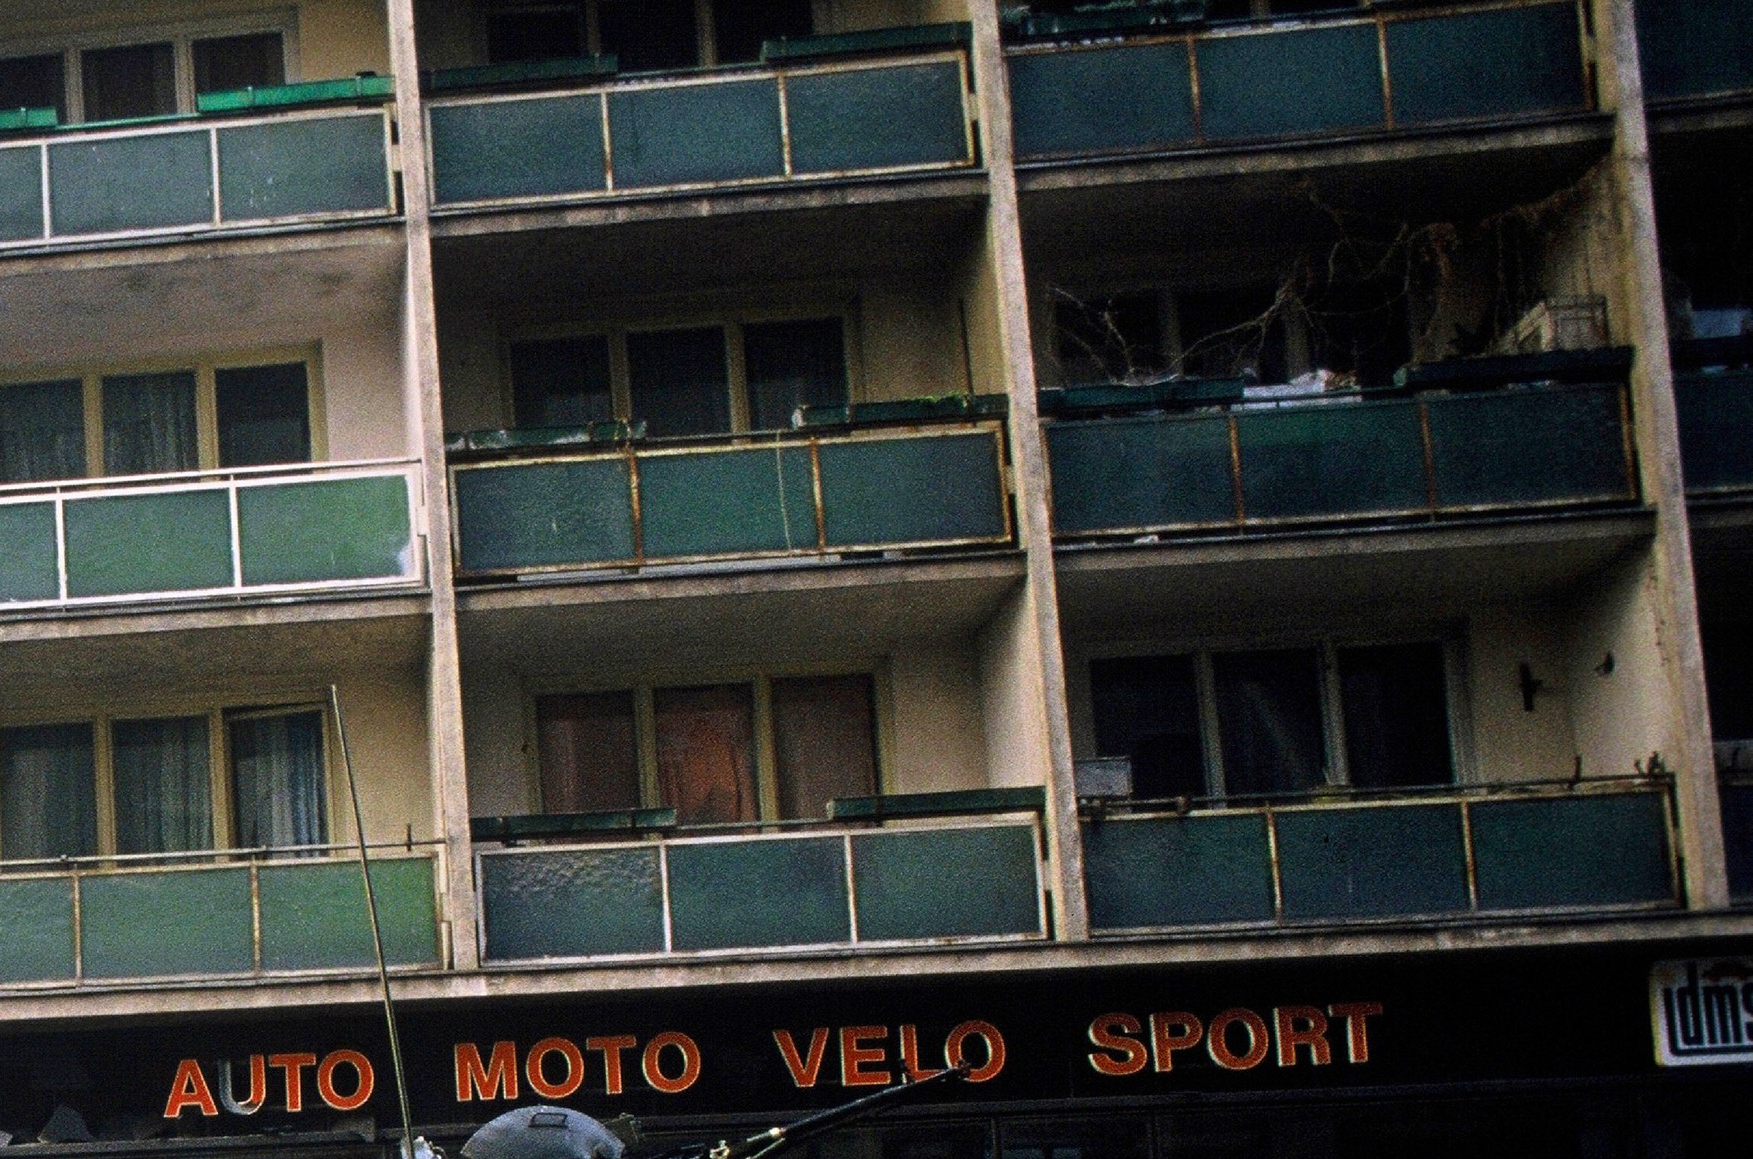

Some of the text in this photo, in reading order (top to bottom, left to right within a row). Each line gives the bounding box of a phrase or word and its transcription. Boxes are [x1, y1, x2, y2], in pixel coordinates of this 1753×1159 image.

[163, 1002, 1383, 1118] AUTO MOTO VELO SPORT
